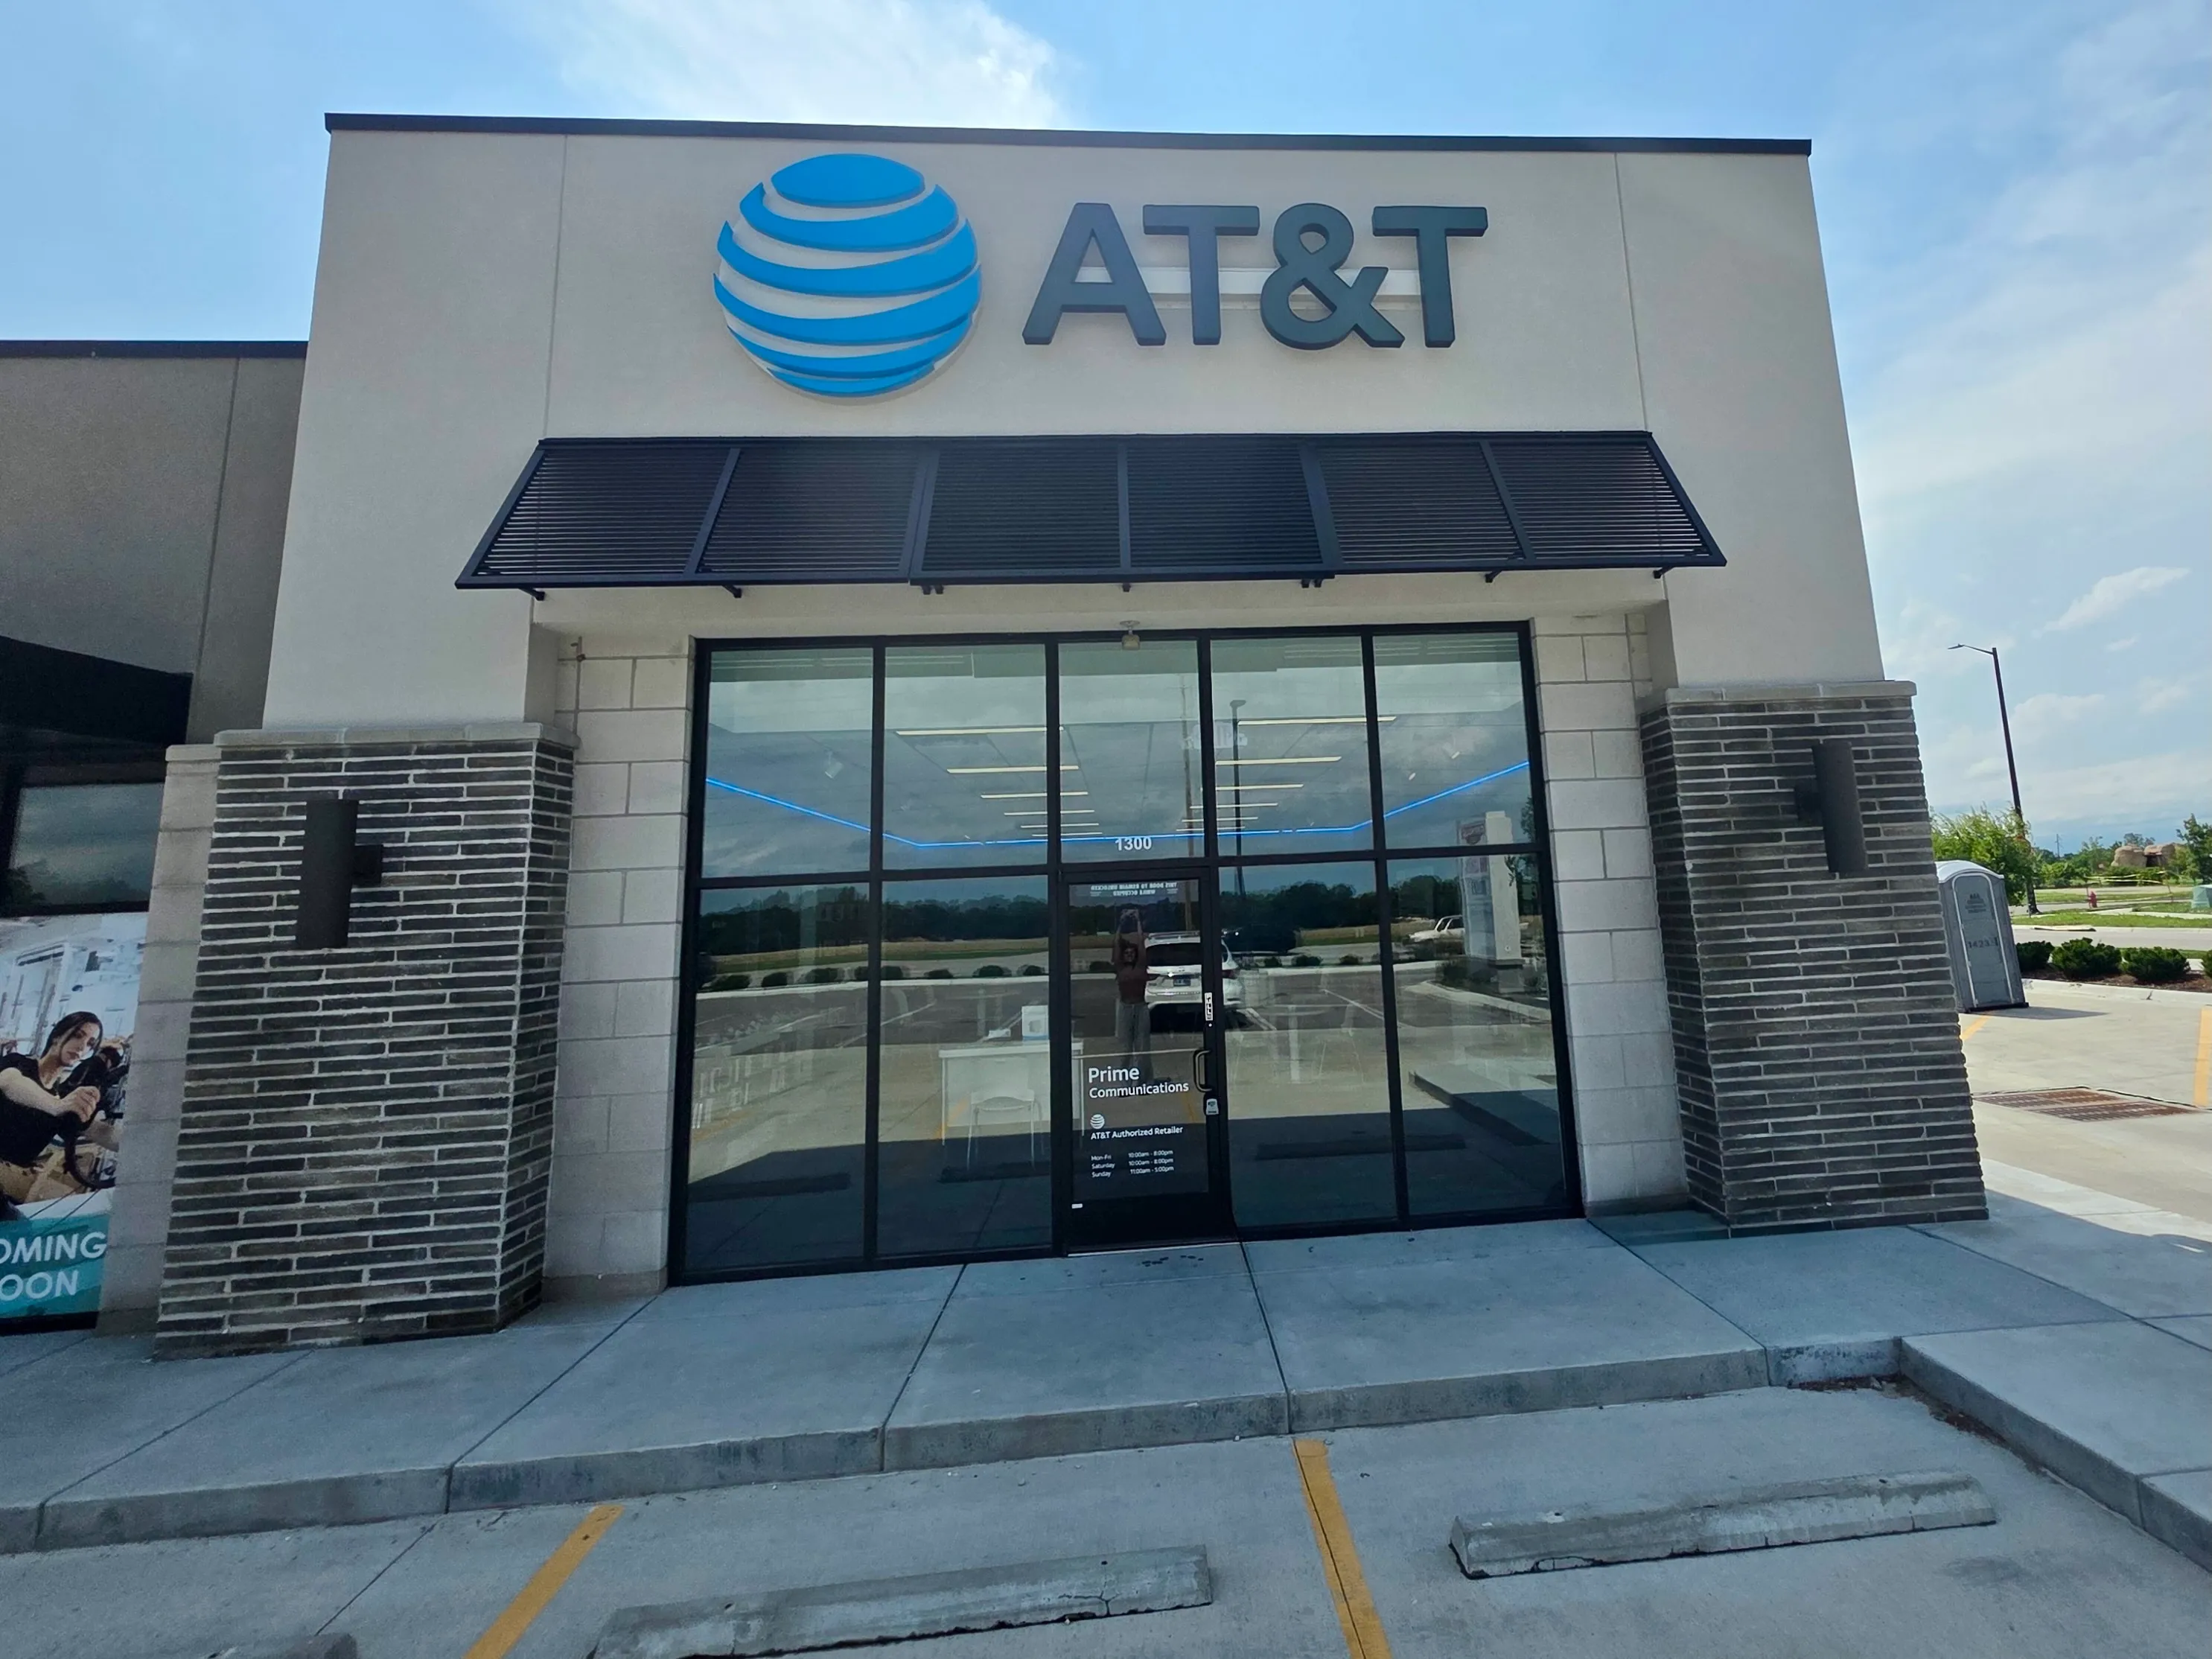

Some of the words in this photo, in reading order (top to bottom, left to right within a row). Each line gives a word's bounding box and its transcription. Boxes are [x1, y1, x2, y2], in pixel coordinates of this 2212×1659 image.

[1022, 202, 1488, 350] AT&T
[1115, 837, 1152, 851] 1300
[1089, 1066, 1140, 1083] Prime
[1089, 1081, 1190, 1098] Communications
[1091, 1131, 1110, 1140] AT&T
[1112, 1127, 1153, 1139] Authorized
[1154, 1126, 1183, 1135] Retailer
[0, 1270, 79, 1302] OON
